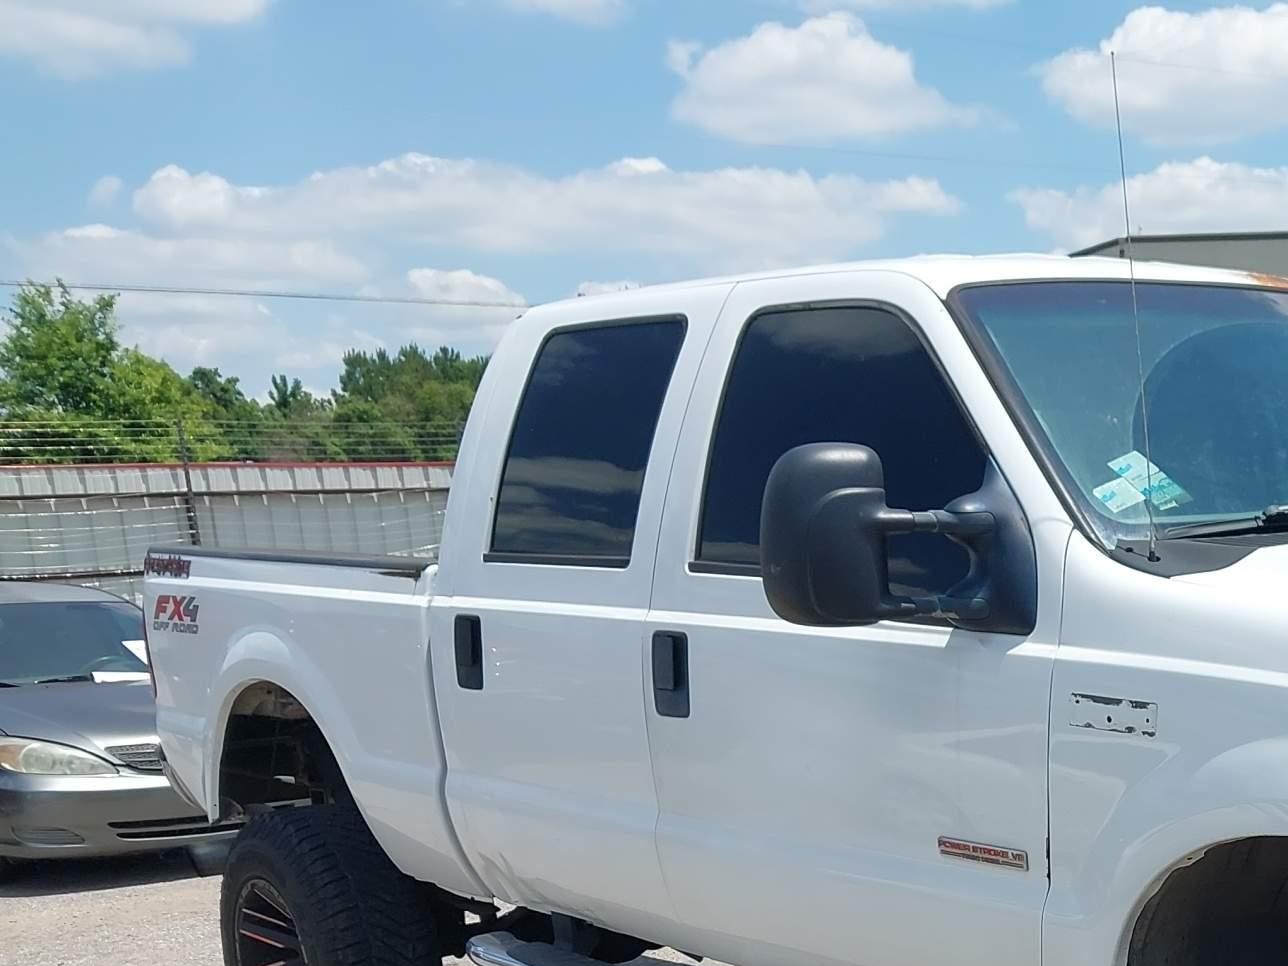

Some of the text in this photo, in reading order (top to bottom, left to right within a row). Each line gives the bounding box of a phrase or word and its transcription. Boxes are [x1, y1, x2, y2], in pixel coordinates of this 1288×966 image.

[154, 594, 199, 622] FX4
[153, 621, 199, 635] OFF ROAD
